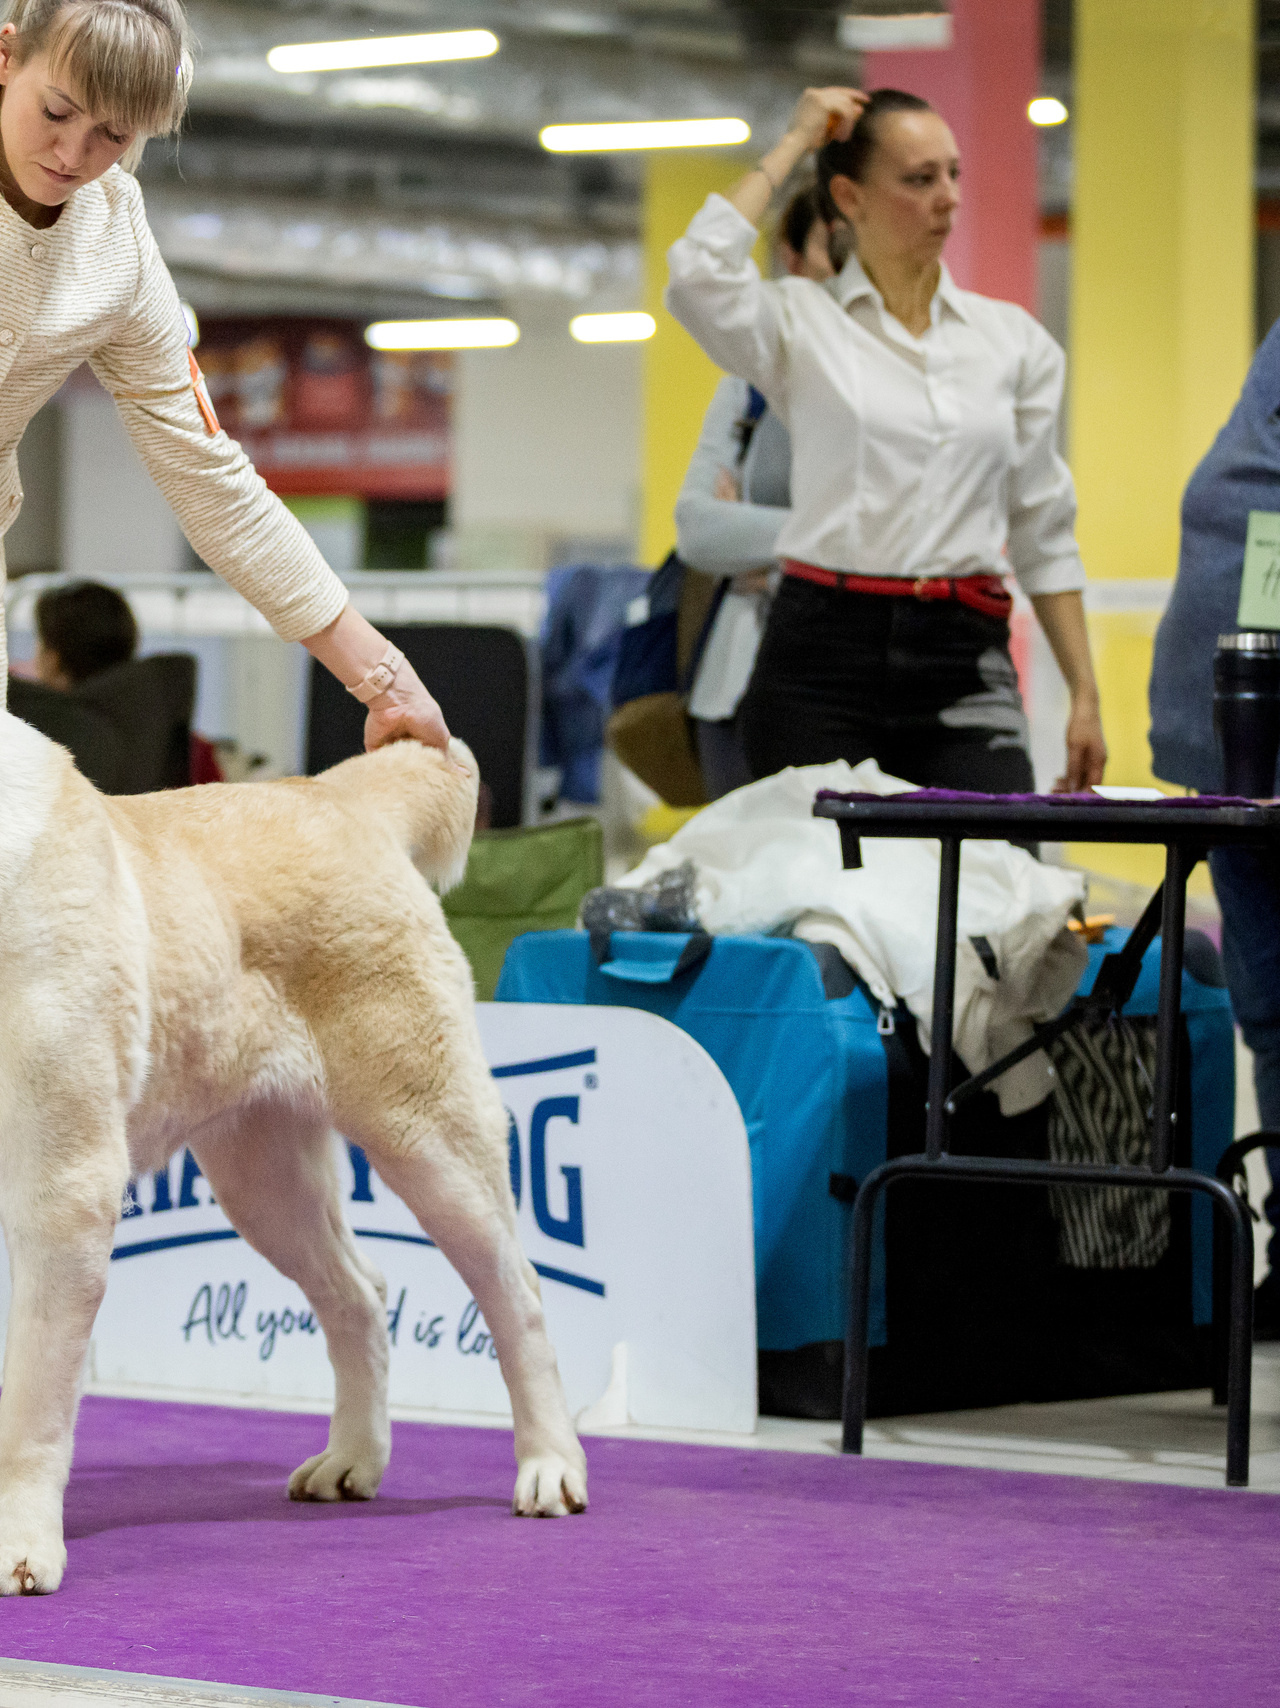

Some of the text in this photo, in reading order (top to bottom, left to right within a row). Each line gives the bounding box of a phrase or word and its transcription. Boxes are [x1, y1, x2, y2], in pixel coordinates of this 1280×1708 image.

[182, 1278, 248, 1346] All
[257, 1308, 318, 1360] you
[414, 1309, 444, 1349] is
